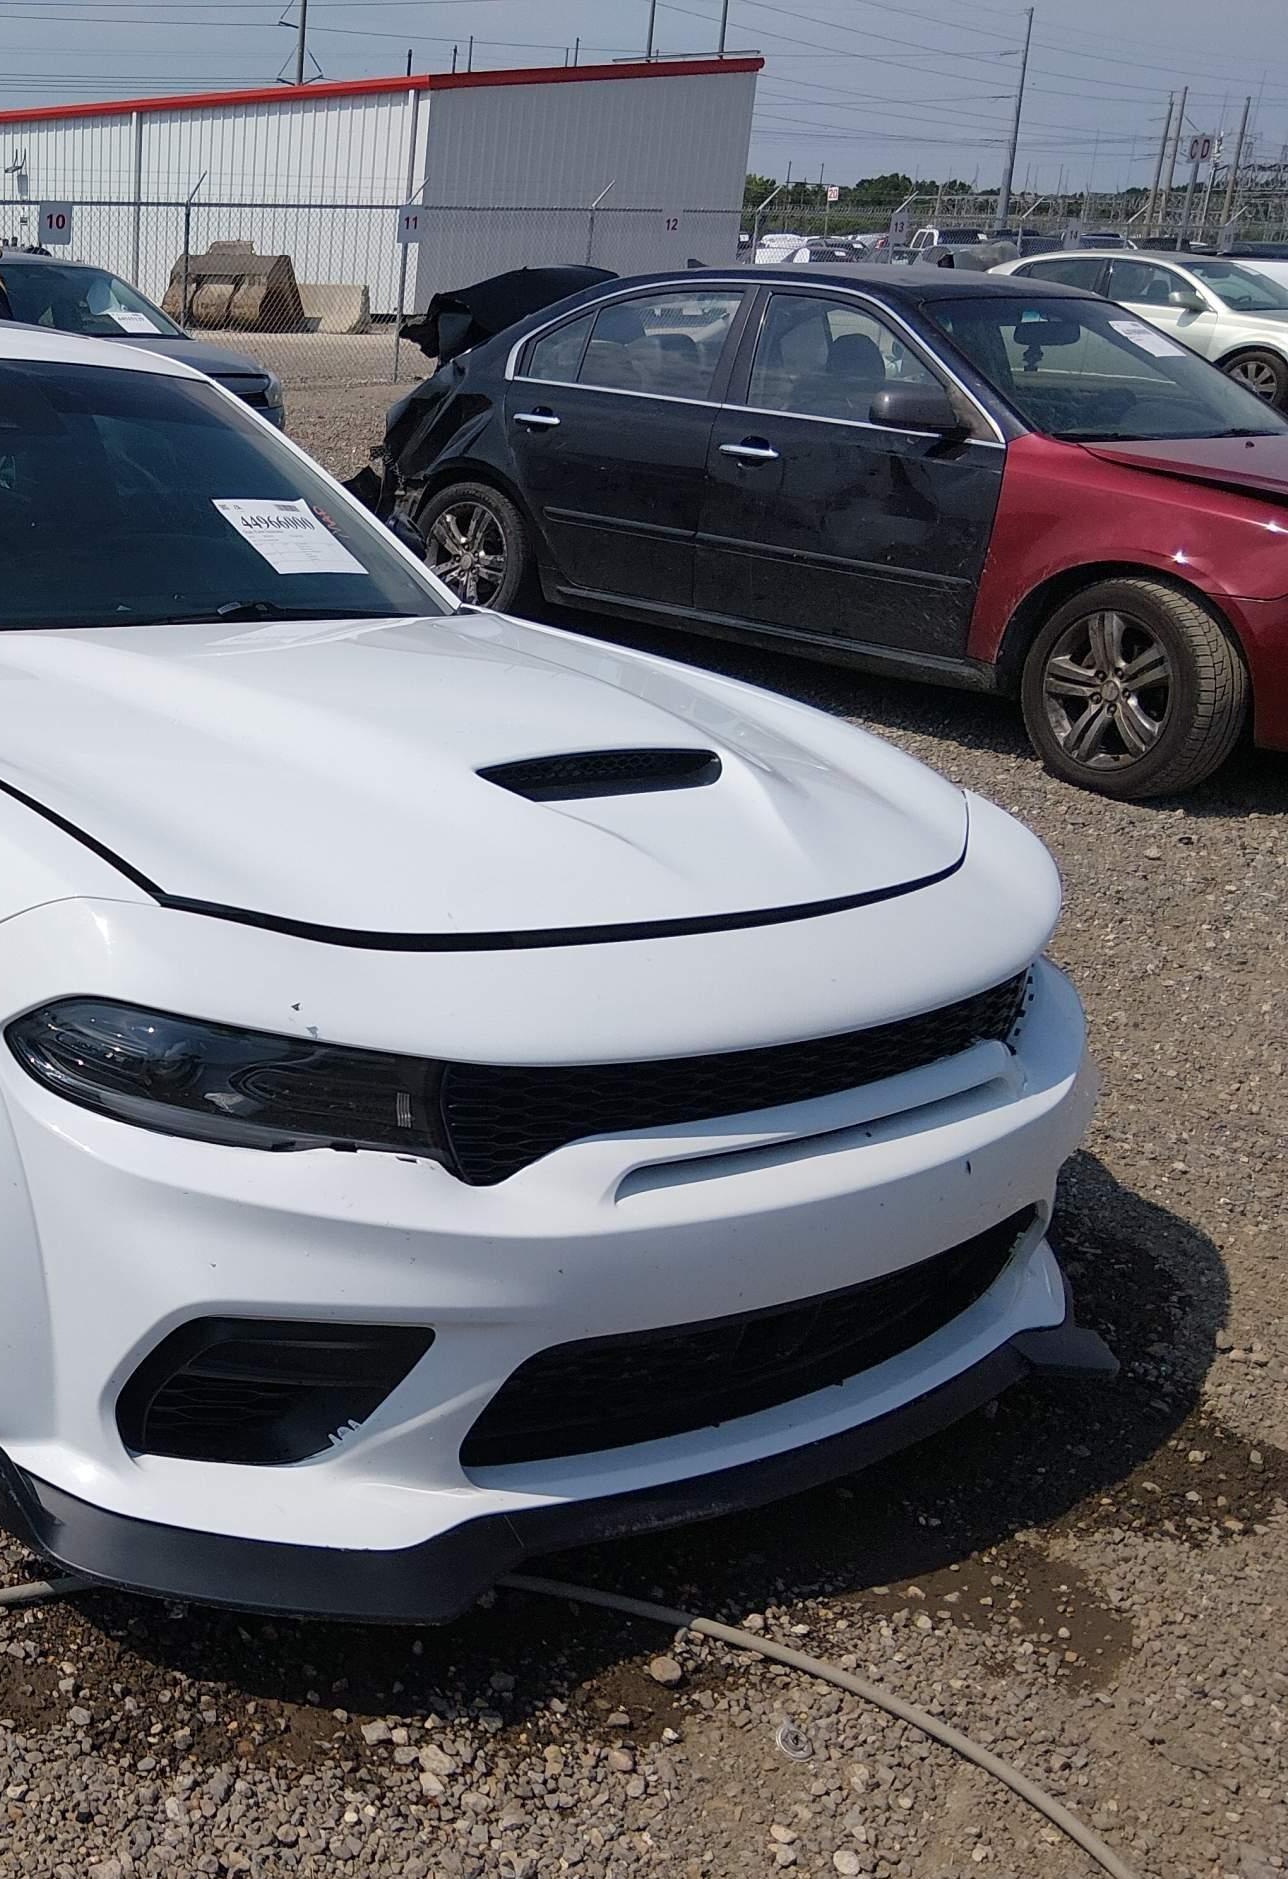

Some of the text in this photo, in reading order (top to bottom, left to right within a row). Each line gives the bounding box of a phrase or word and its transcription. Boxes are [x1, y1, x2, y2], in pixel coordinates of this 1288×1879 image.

[828, 188, 838, 199] 20
[46, 213, 66, 230] 10
[404, 215, 418, 230] 11
[665, 217, 679, 231] 12
[894, 221, 905, 233] 13
[240, 515, 316, 531] 44966000
